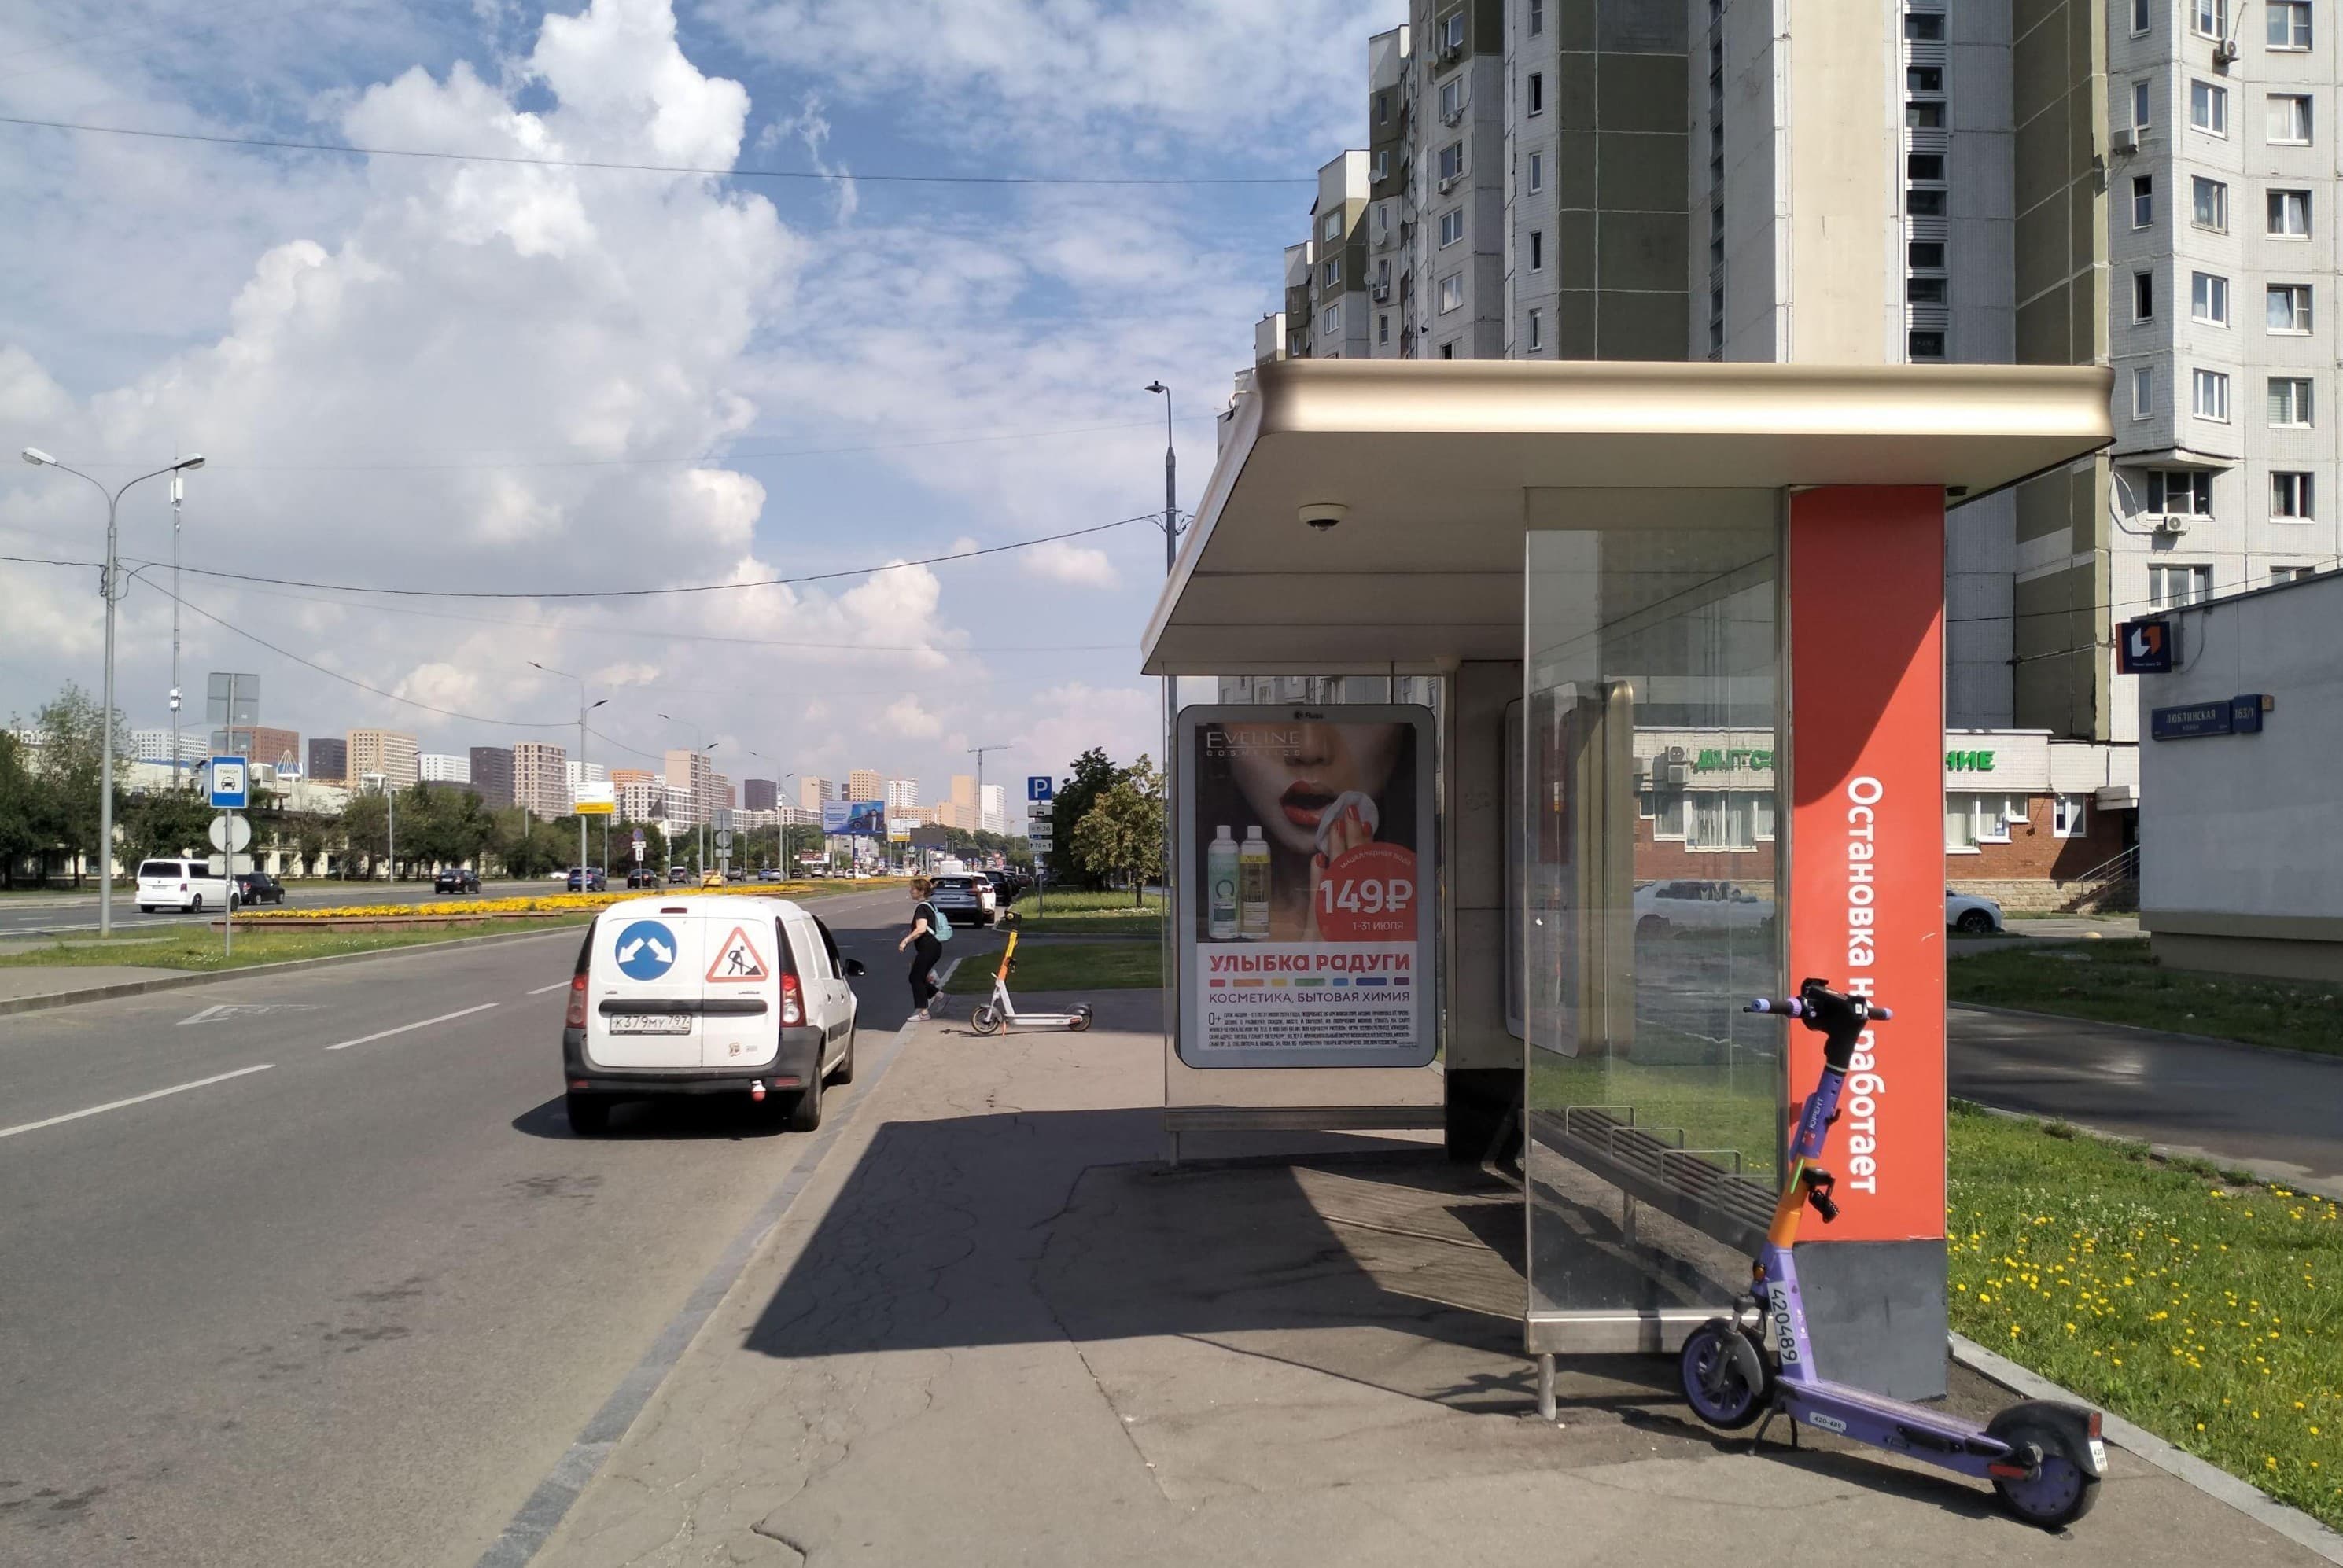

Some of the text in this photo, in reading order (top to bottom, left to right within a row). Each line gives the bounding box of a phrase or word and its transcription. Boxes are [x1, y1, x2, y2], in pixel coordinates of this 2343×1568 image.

[2166, 709, 2216, 723] ЛЮБЛИНСКАЯ
[1206, 731, 1300, 748] EVELINE
[1034, 778, 1048, 798] P
[1848, 776, 1884, 968] Остановка
[1373, 921, 1404, 930] ИЮЛЯ
[1209, 991, 1410, 1004] КОСМЕТИКА, БЫТОВАЯ ХИМИЯ
[1208, 1012, 1222, 1025] 0+
[1848, 1029, 1886, 1194] работает
[1771, 1289, 1798, 1361] 420489
[1814, 1415, 1842, 1428] 420-489
